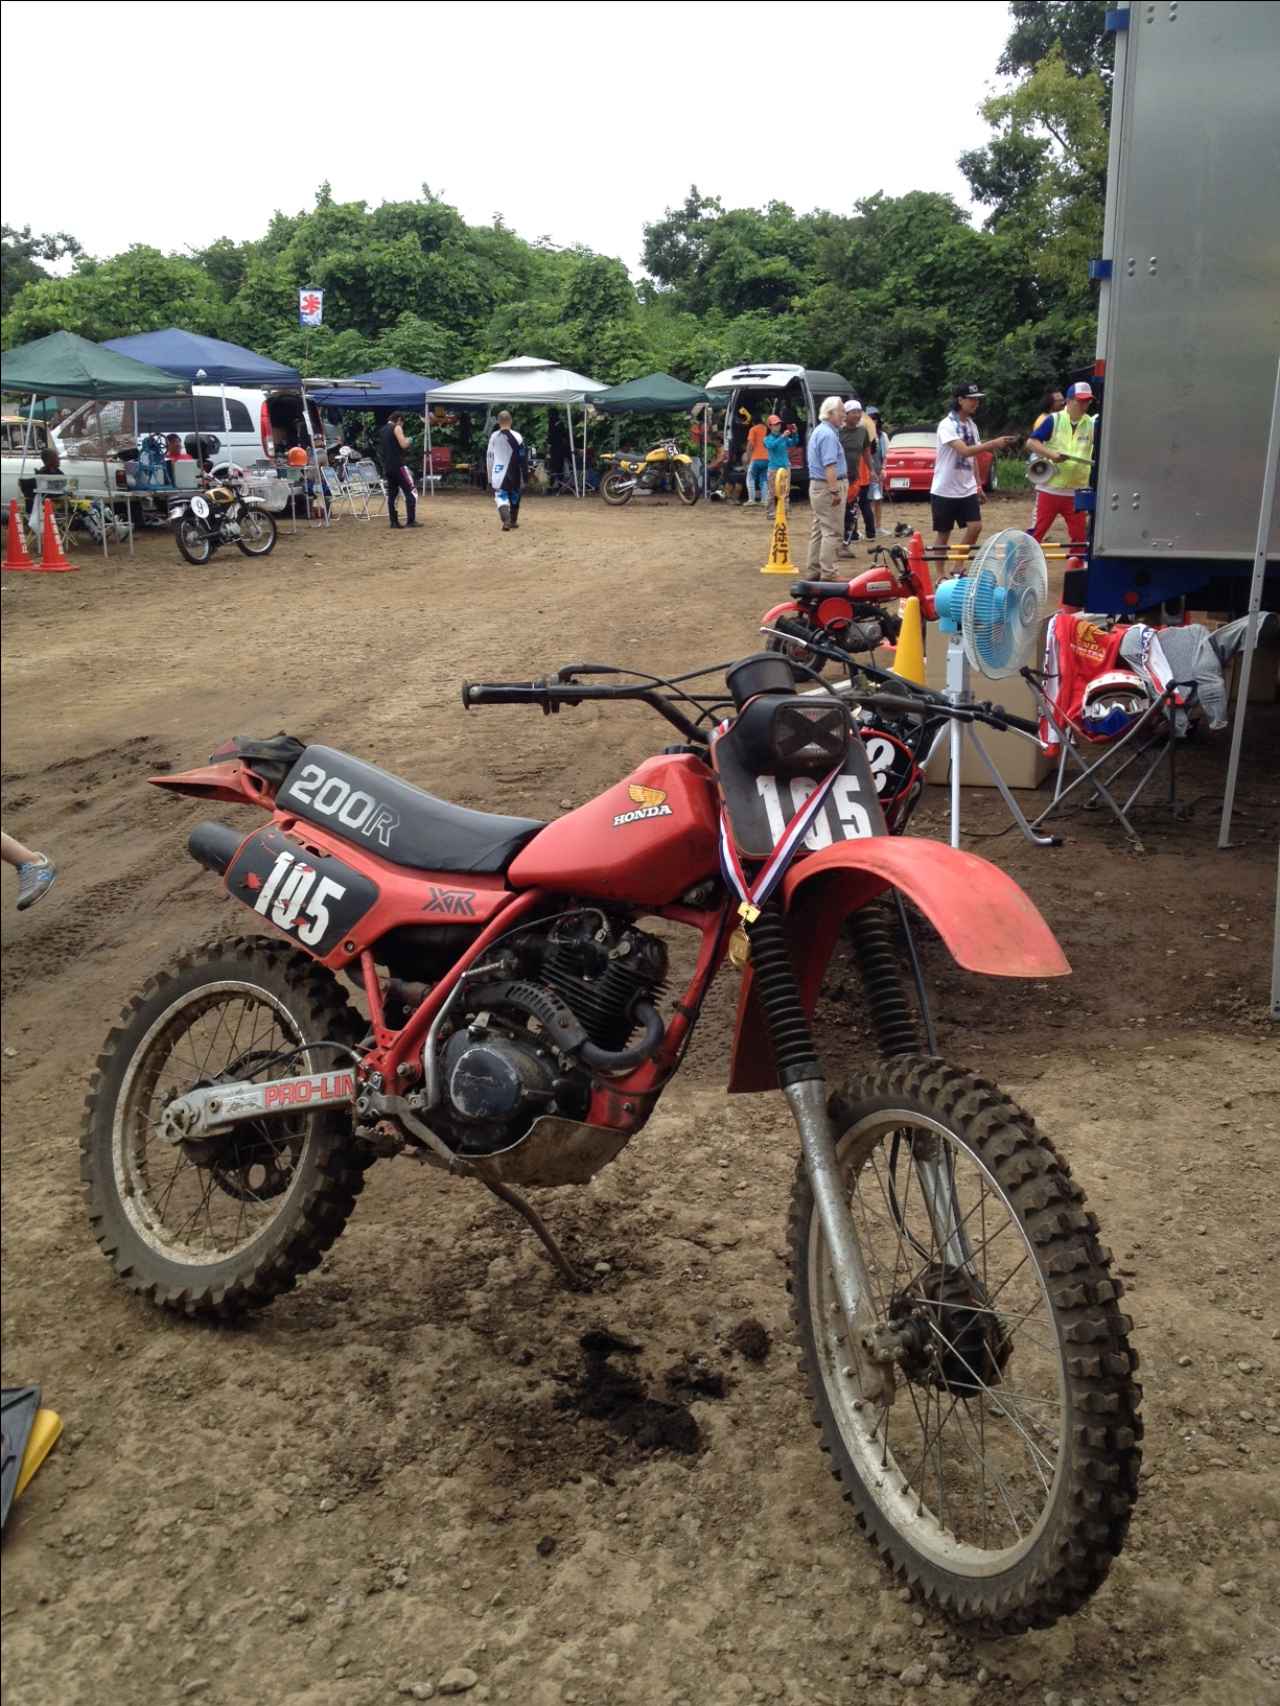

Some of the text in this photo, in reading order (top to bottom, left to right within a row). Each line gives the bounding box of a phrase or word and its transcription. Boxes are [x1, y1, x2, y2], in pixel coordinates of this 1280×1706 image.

[288, 763, 400, 847] 200R
[613, 804, 672, 826] HONDA
[756, 774, 874, 850] 105
[254, 850, 347, 946] 105
[422, 887, 477, 916] XR
